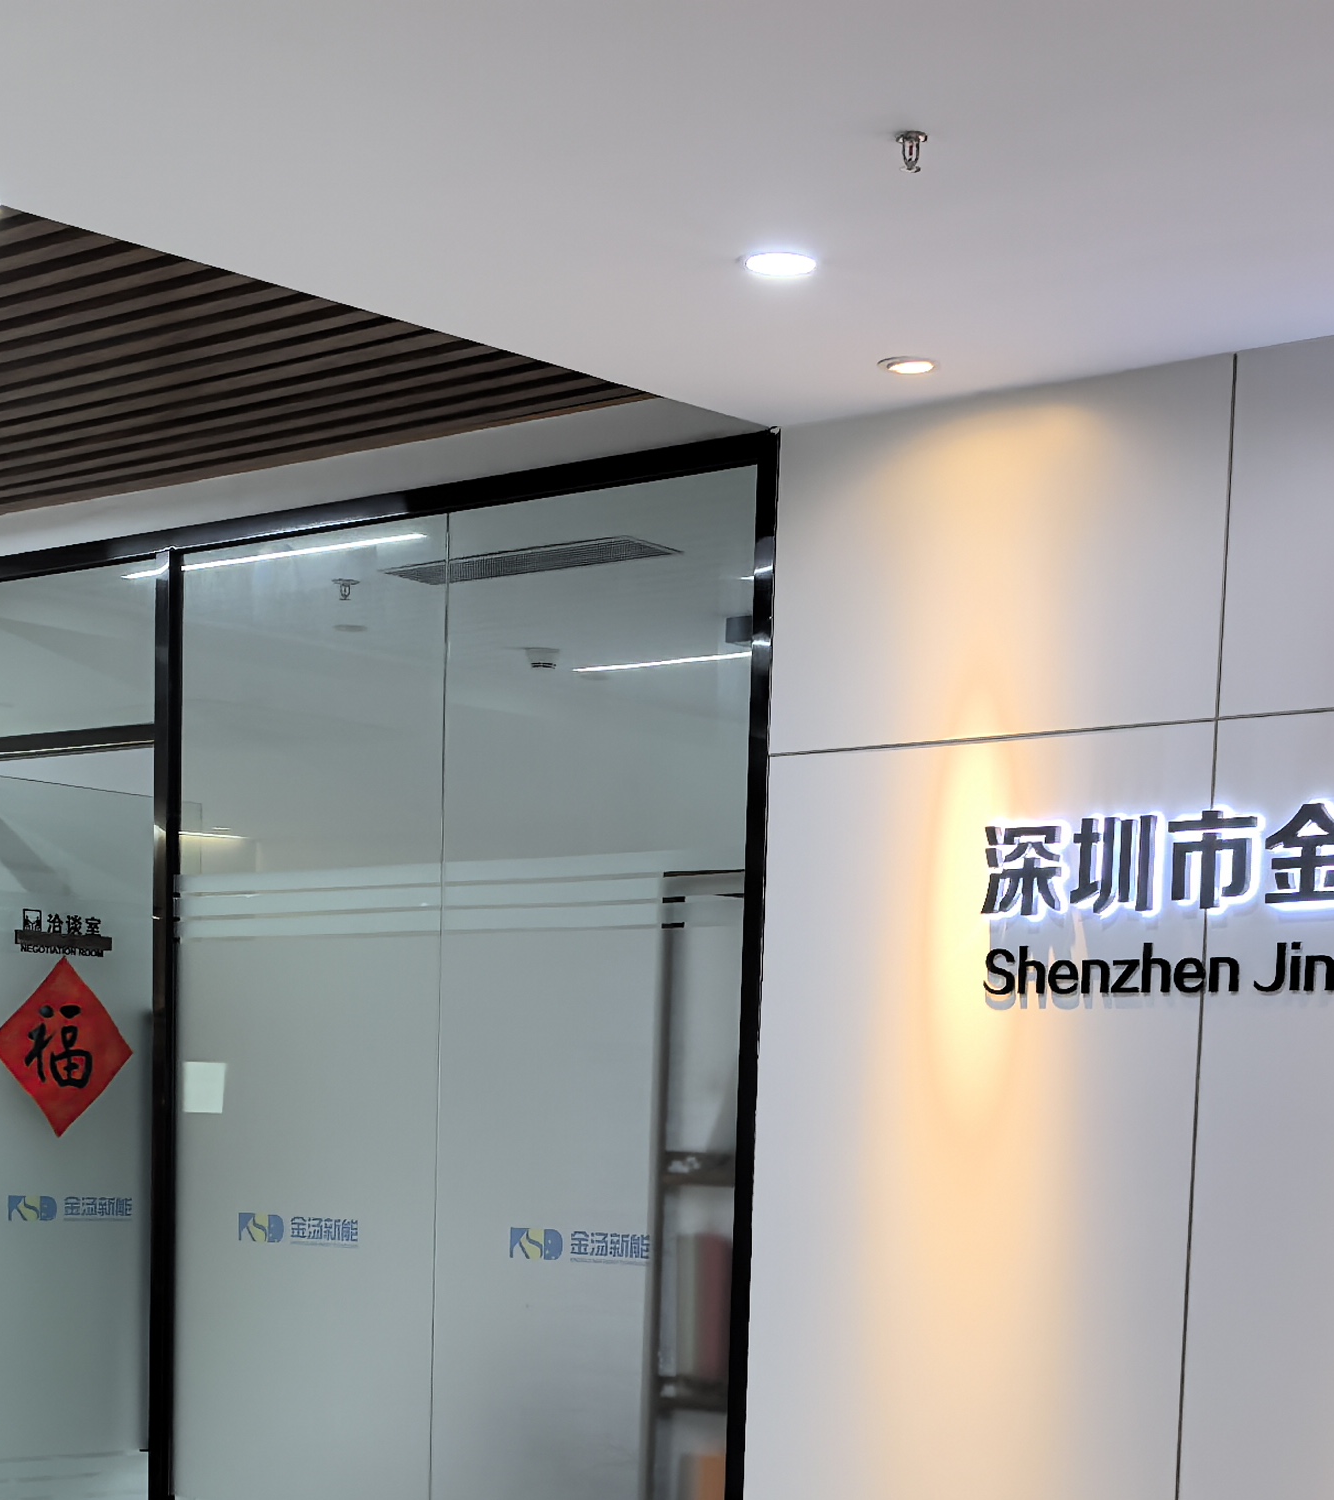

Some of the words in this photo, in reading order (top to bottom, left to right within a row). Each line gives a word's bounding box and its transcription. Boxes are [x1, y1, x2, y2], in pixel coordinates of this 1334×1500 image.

[47, 913, 101, 937] 洽谈室
[20, 943, 76, 956] NEGOTIATION
[78, 947, 104, 957] ROOM
[983, 942, 1239, 995] Shenzhen
[24, 1004, 93, 1089] 福
[290, 1216, 358, 1241] 金汤新能
[570, 1231, 650, 1259] 金汤新能
